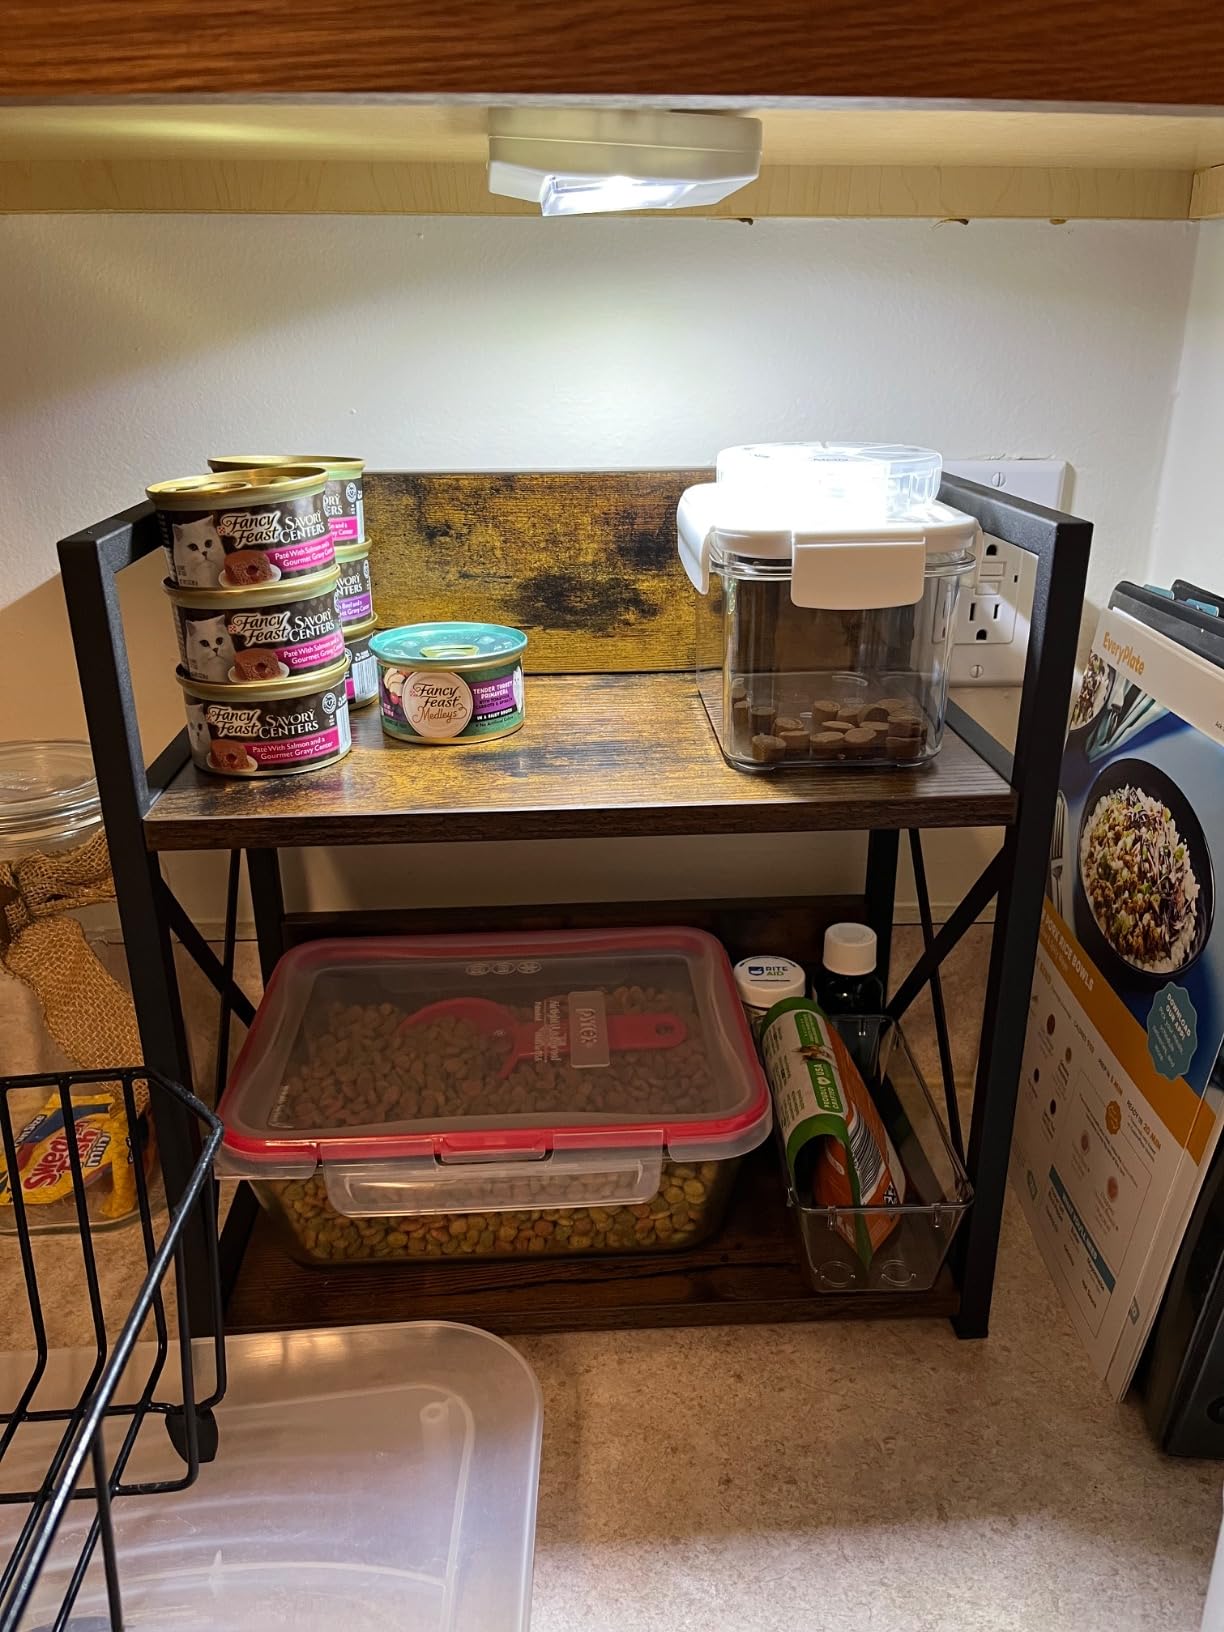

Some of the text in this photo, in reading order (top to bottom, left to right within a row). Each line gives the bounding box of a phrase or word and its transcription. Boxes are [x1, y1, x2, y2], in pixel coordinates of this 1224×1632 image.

[222, 513, 276, 531] Fancy
[285, 510, 321, 531] SAVORY
[235, 527, 279, 547] Feast
[280, 521, 325, 543] CENTERS
[289, 547, 304, 557] With
[283, 556, 311, 567] Gourmet
[233, 613, 285, 629] Fancy
[295, 609, 332, 629] SAVORY
[245, 626, 288, 645] Feast
[289, 621, 335, 642] CENTERS
[298, 645, 313, 654] With
[1103, 631, 1145, 676] EveryPlate
[291, 654, 320, 664] Gourmet
[413, 682, 460, 697] Fancy
[473, 686, 496, 695] TENDER
[481, 689, 509, 700] PRIMAVERA
[424, 694, 460, 708] Feast
[208, 706, 255, 722] Fancy
[266, 709, 315, 728] SAVORY
[413, 704, 467, 724] Medleys
[218, 720, 259, 736] Feast
[259, 719, 319, 739] CENTERS
[261, 741, 334, 760] Gourmet Gravy Center
[286, 741, 310, 750] Salmon
[310, 737, 321, 745] and
[1072, 954, 1094, 991] BOWLS
[1166, 1004, 1175, 1022] OUR
[1167, 993, 1191, 1037] DOWNLOAD
[813, 1063, 830, 1108] PROUDLY USA
